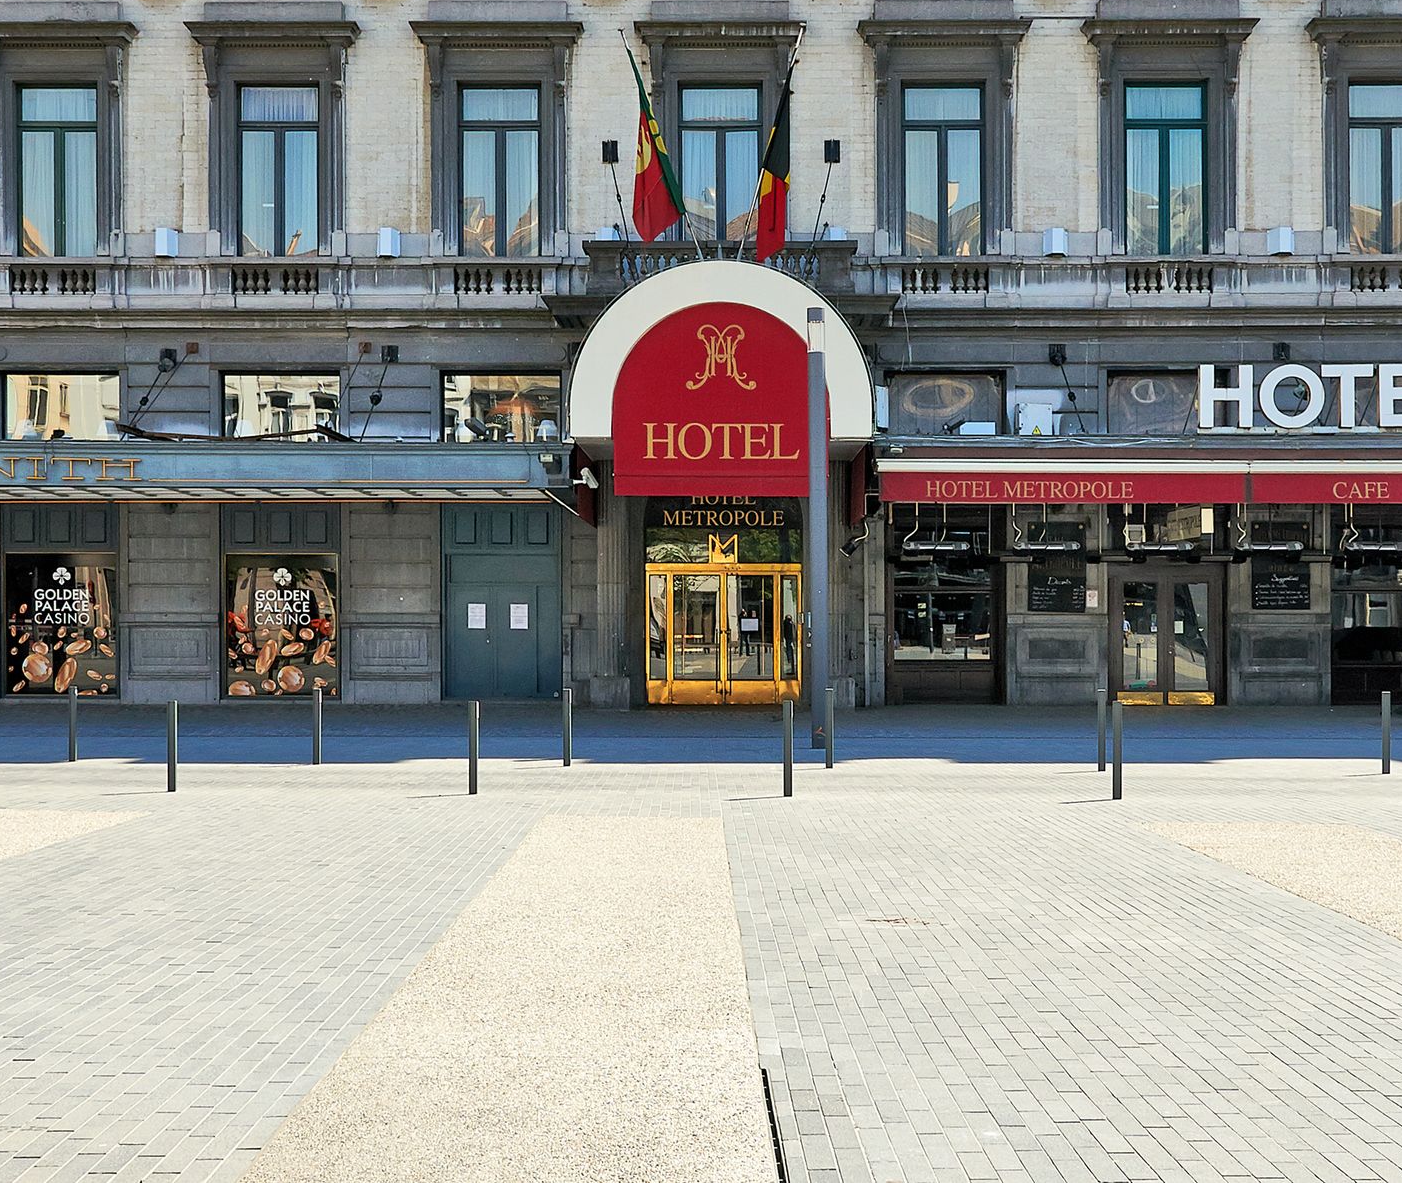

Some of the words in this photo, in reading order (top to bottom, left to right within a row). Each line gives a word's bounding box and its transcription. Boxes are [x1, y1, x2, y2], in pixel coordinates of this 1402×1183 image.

[642, 422, 800, 460] HOTEL
[926, 481, 998, 498] HOTEL
[1002, 481, 1134, 499] METROPOLE
[1332, 481, 1389, 499] CAFE
[663, 510, 785, 526] METROPOLE
[34, 588, 90, 601] GOLDEN
[254, 589, 310, 602] GOLDEN
[35, 600, 89, 612] PALACE
[255, 601, 310, 613] PALACE
[34, 612, 90, 625] CASINO
[254, 613, 311, 625] CASINO
